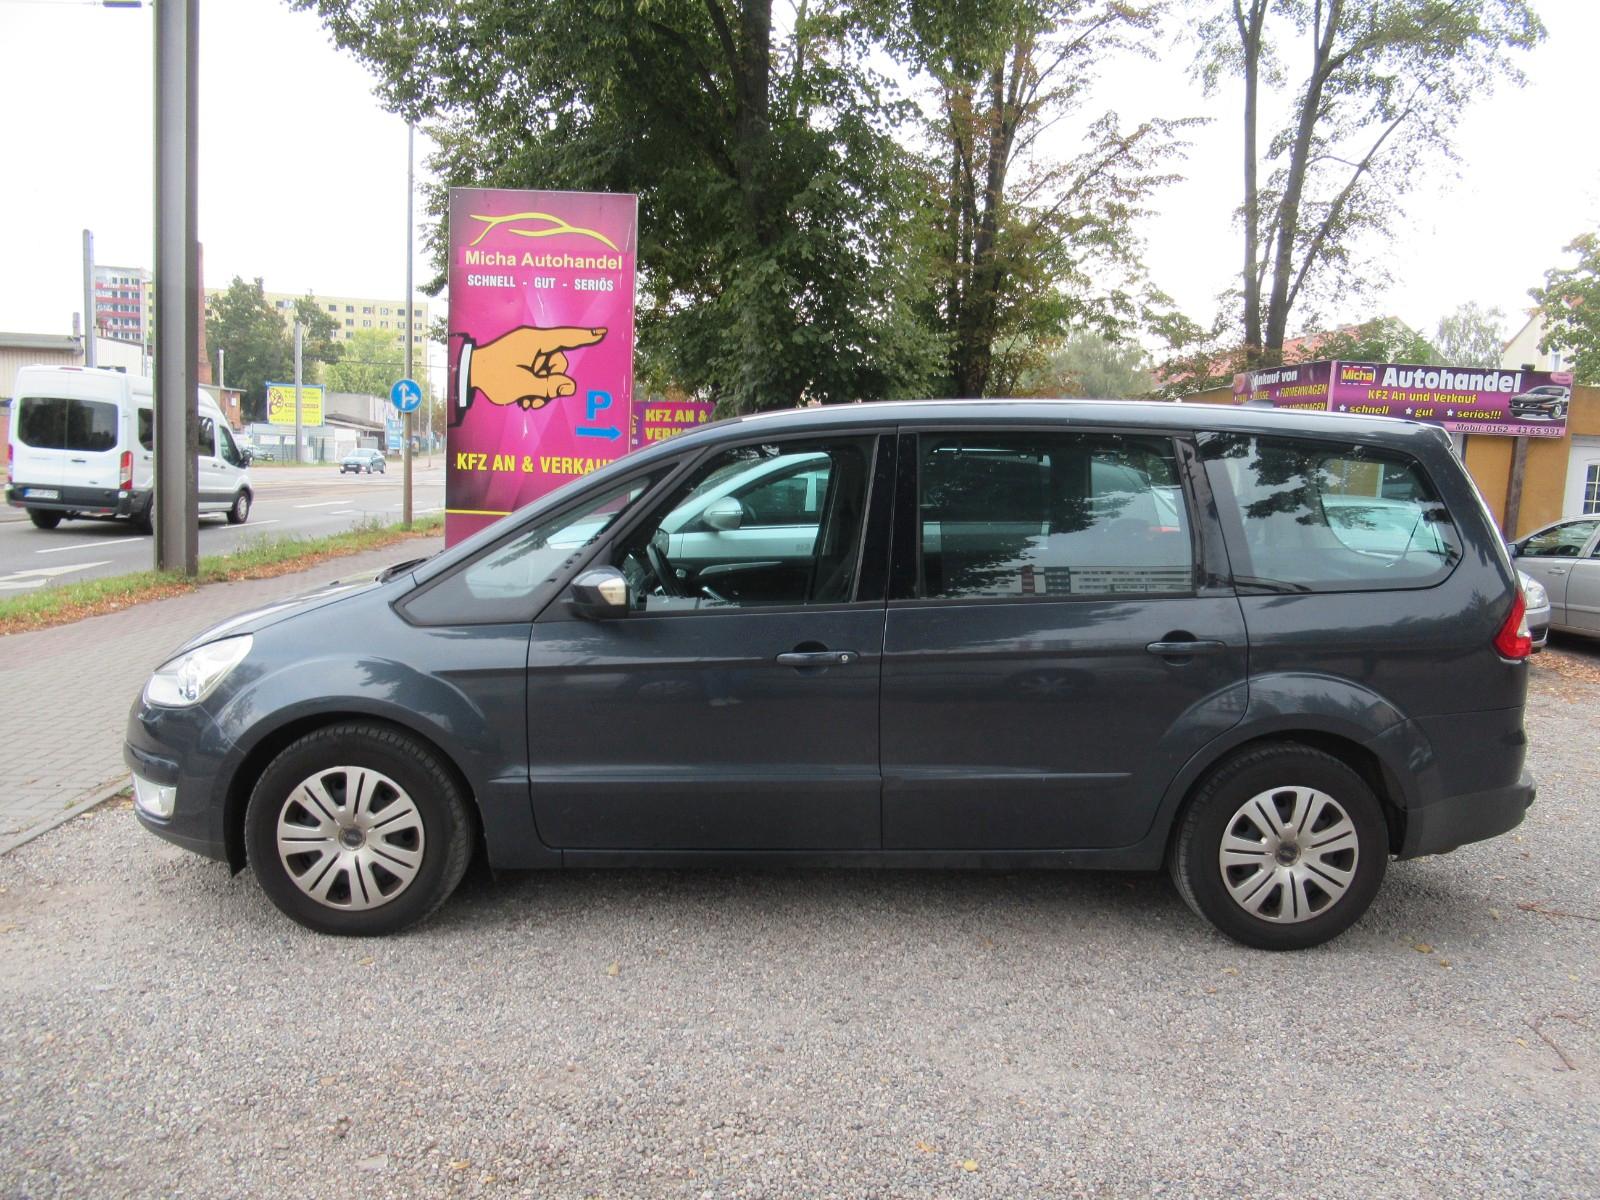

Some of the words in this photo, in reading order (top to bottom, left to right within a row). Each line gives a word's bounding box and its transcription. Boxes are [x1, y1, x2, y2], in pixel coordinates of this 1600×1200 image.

[465, 250, 516, 266] Micha
[521, 252, 622, 270] Autohandel
[467, 274, 516, 288] SCHNELL
[534, 276, 556, 289] GUT
[574, 277, 614, 291] SERIÖS
[1281, 370, 1298, 383] von
[1342, 369, 1374, 381] Micha
[1381, 367, 1522, 393] Autohandel
[1280, 383, 1328, 398] FIRMENWAGEN
[1368, 389, 1389, 400] KFZ
[1391, 390, 1406, 401] An
[1409, 391, 1430, 402] und
[1434, 392, 1477, 403] Verkauf
[586, 390, 613, 421] P
[1349, 404, 1389, 415] schnell
[1414, 406, 1434, 418] gut
[1457, 408, 1502, 420] seriös!!!
[645, 408, 672, 423] KFZ
[674, 409, 695, 423] AN
[698, 410, 708, 423] &
[1486, 424, 1509, 433] 0162
[1543, 427, 1561, 436] 991
[457, 452, 488, 471] KFZ
[492, 454, 515, 472] AN
[522, 455, 534, 473] &
